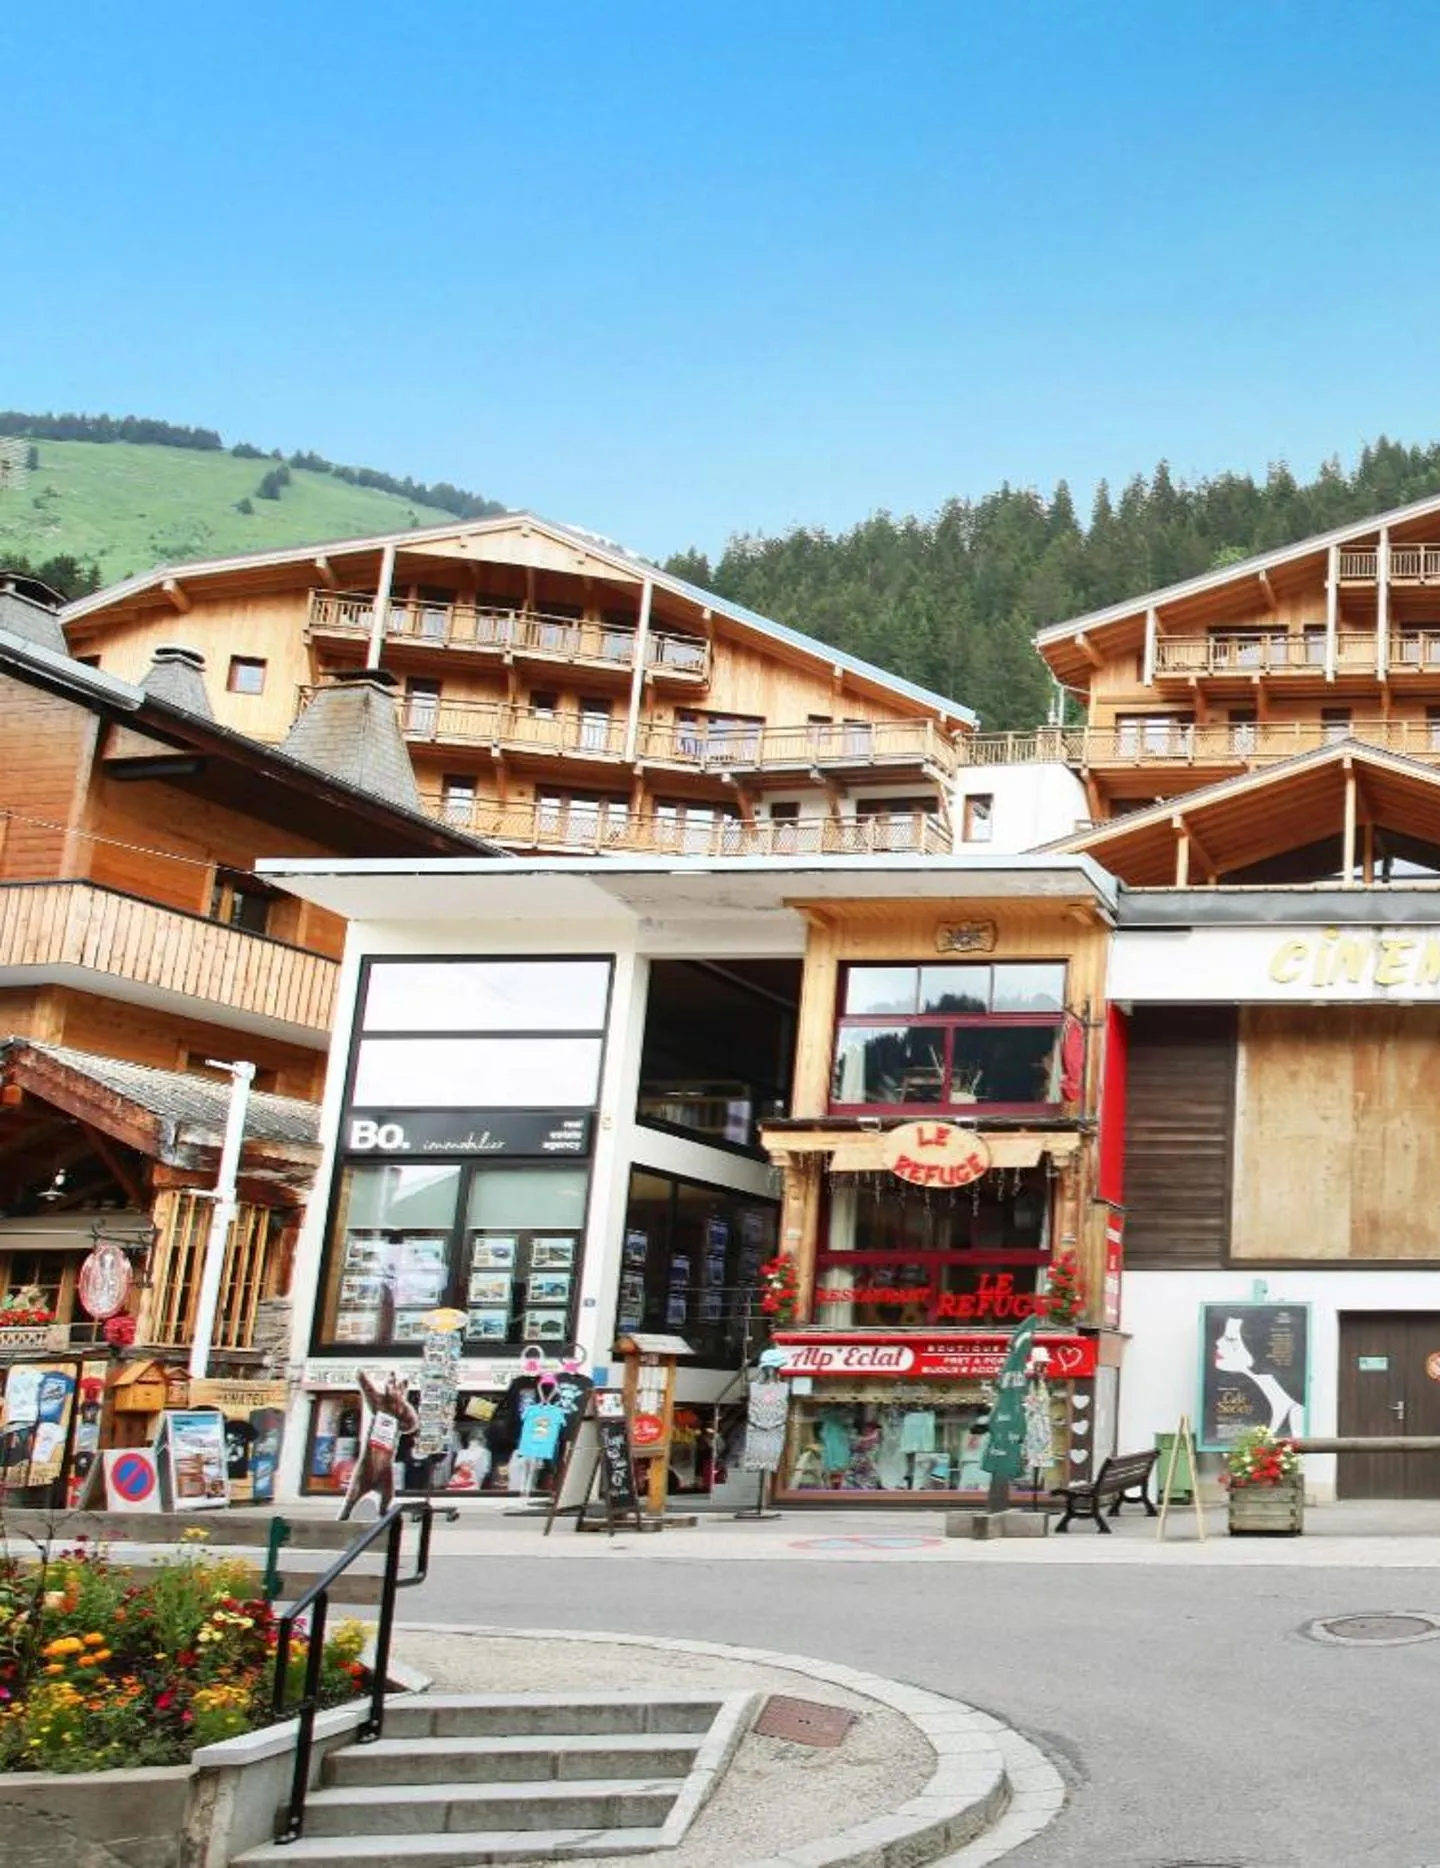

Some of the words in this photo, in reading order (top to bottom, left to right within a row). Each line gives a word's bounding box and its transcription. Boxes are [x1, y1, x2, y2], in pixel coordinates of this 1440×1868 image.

[917, 1126, 950, 1148] LE
[893, 1153, 983, 1185] REFUGE
[978, 1273, 1014, 1296] LE
